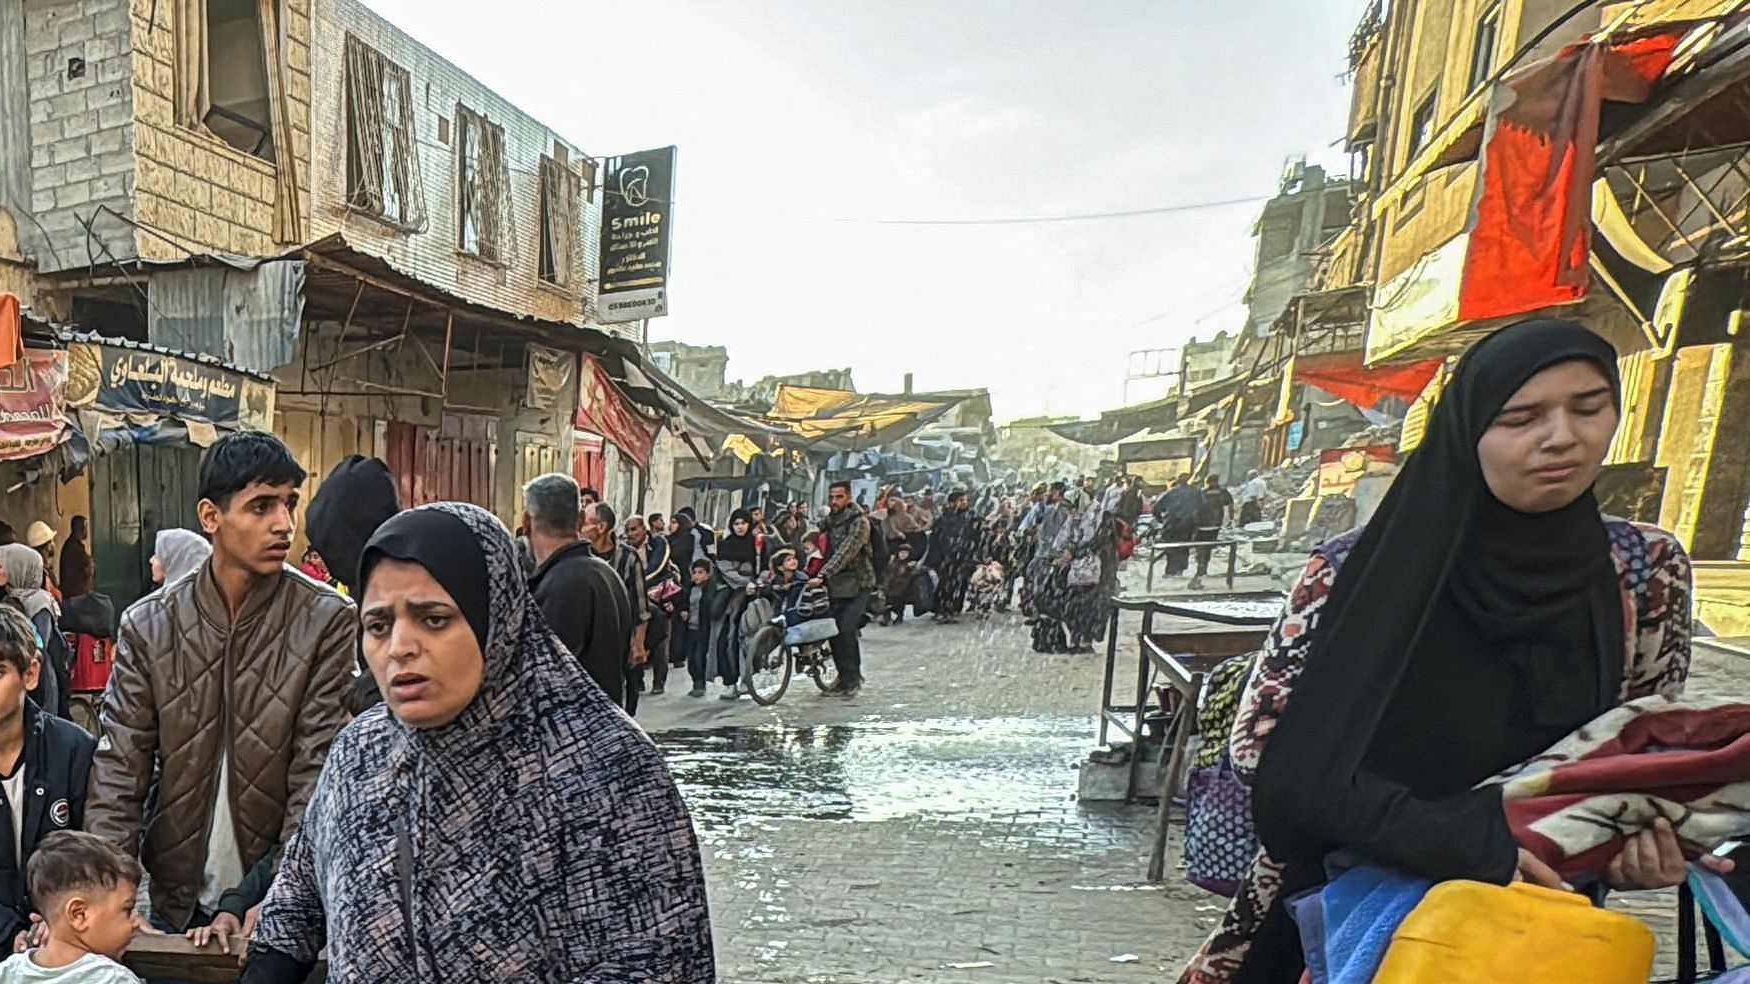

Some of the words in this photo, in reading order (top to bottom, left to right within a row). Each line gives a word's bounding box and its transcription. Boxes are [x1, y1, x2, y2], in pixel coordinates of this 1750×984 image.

[611, 212, 661, 231] Smile
[170, 357, 209, 399] وملحمة
[208, 374, 236, 399] مطعم
